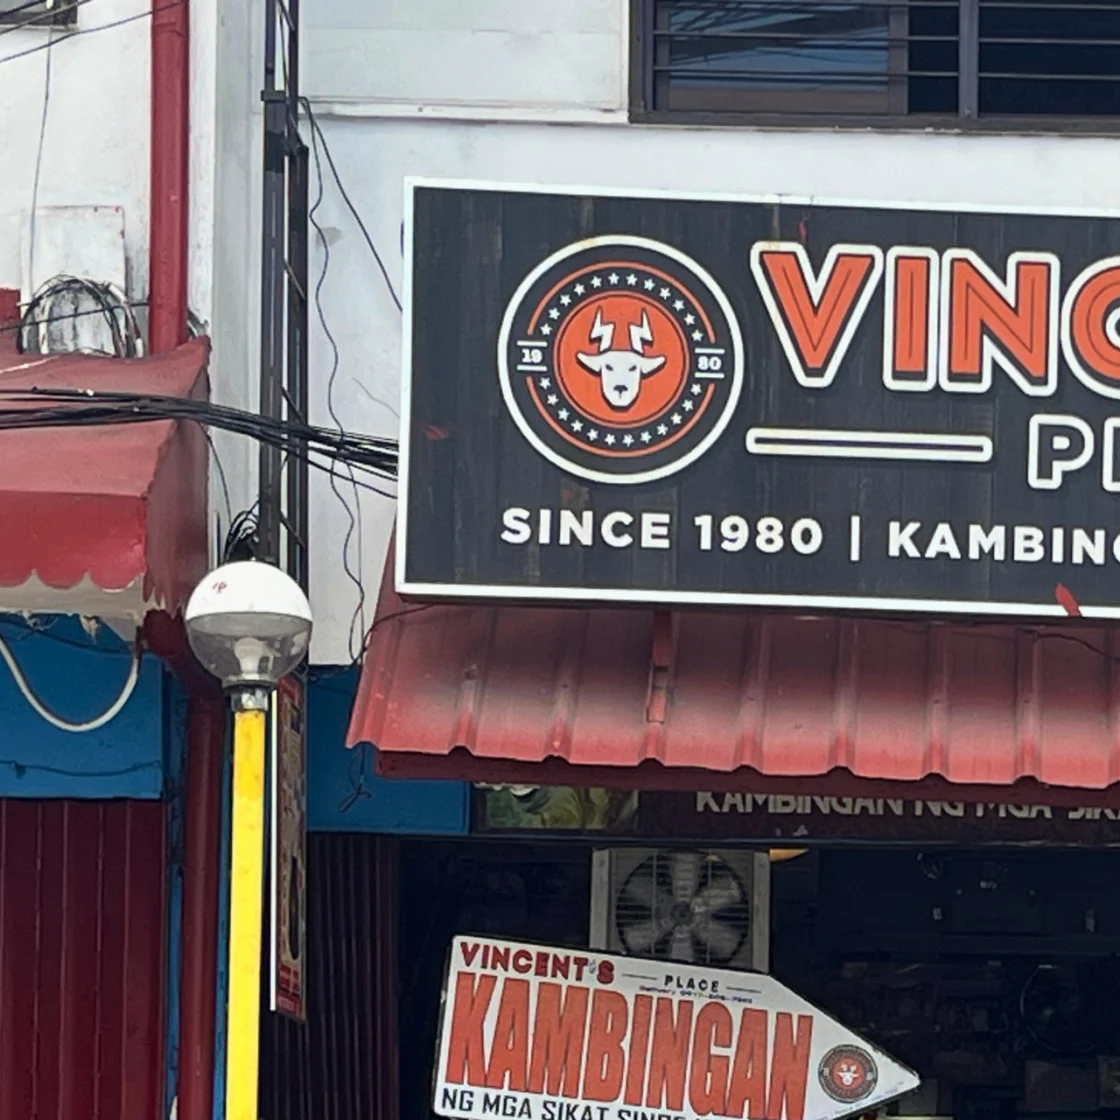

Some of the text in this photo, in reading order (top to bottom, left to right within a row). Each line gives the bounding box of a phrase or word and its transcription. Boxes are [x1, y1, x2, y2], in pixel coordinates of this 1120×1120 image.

[521, 349, 543, 363] 19
[698, 356, 722, 370] 80
[501, 508, 670, 548] SINCE
[695, 515, 823, 554] 1980
[460, 941, 615, 985] VINCENT'S
[664, 974, 720, 993] PLACE
[441, 1087, 474, 1112] NG
[481, 1094, 533, 1119] MGA
